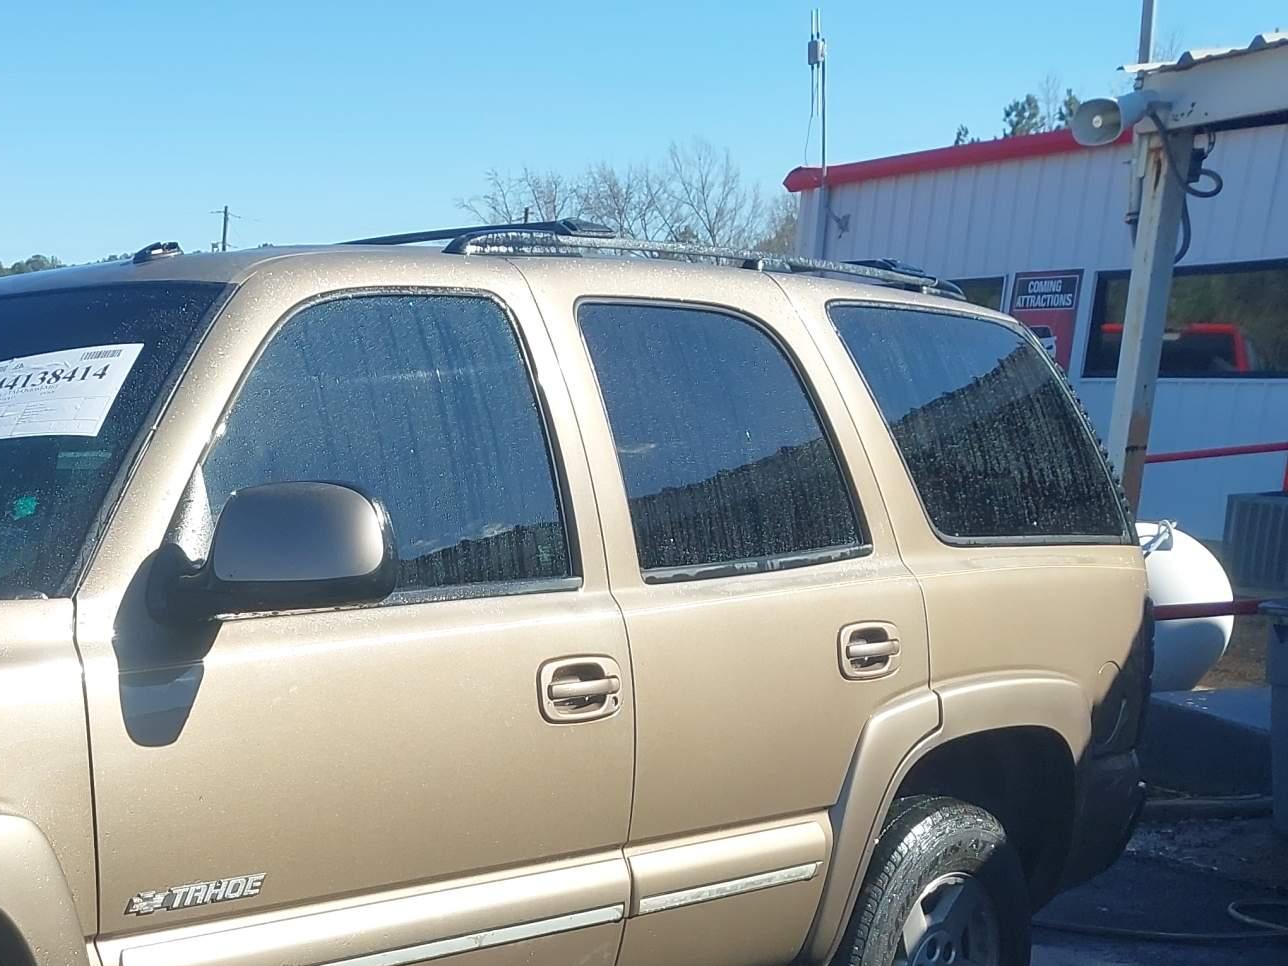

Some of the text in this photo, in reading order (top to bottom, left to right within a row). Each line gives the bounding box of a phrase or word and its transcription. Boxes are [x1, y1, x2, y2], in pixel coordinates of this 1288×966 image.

[1027, 279, 1063, 294] COMING
[1015, 293, 1073, 308] ATTRACTIONS
[169, 872, 267, 908] TAHOE
